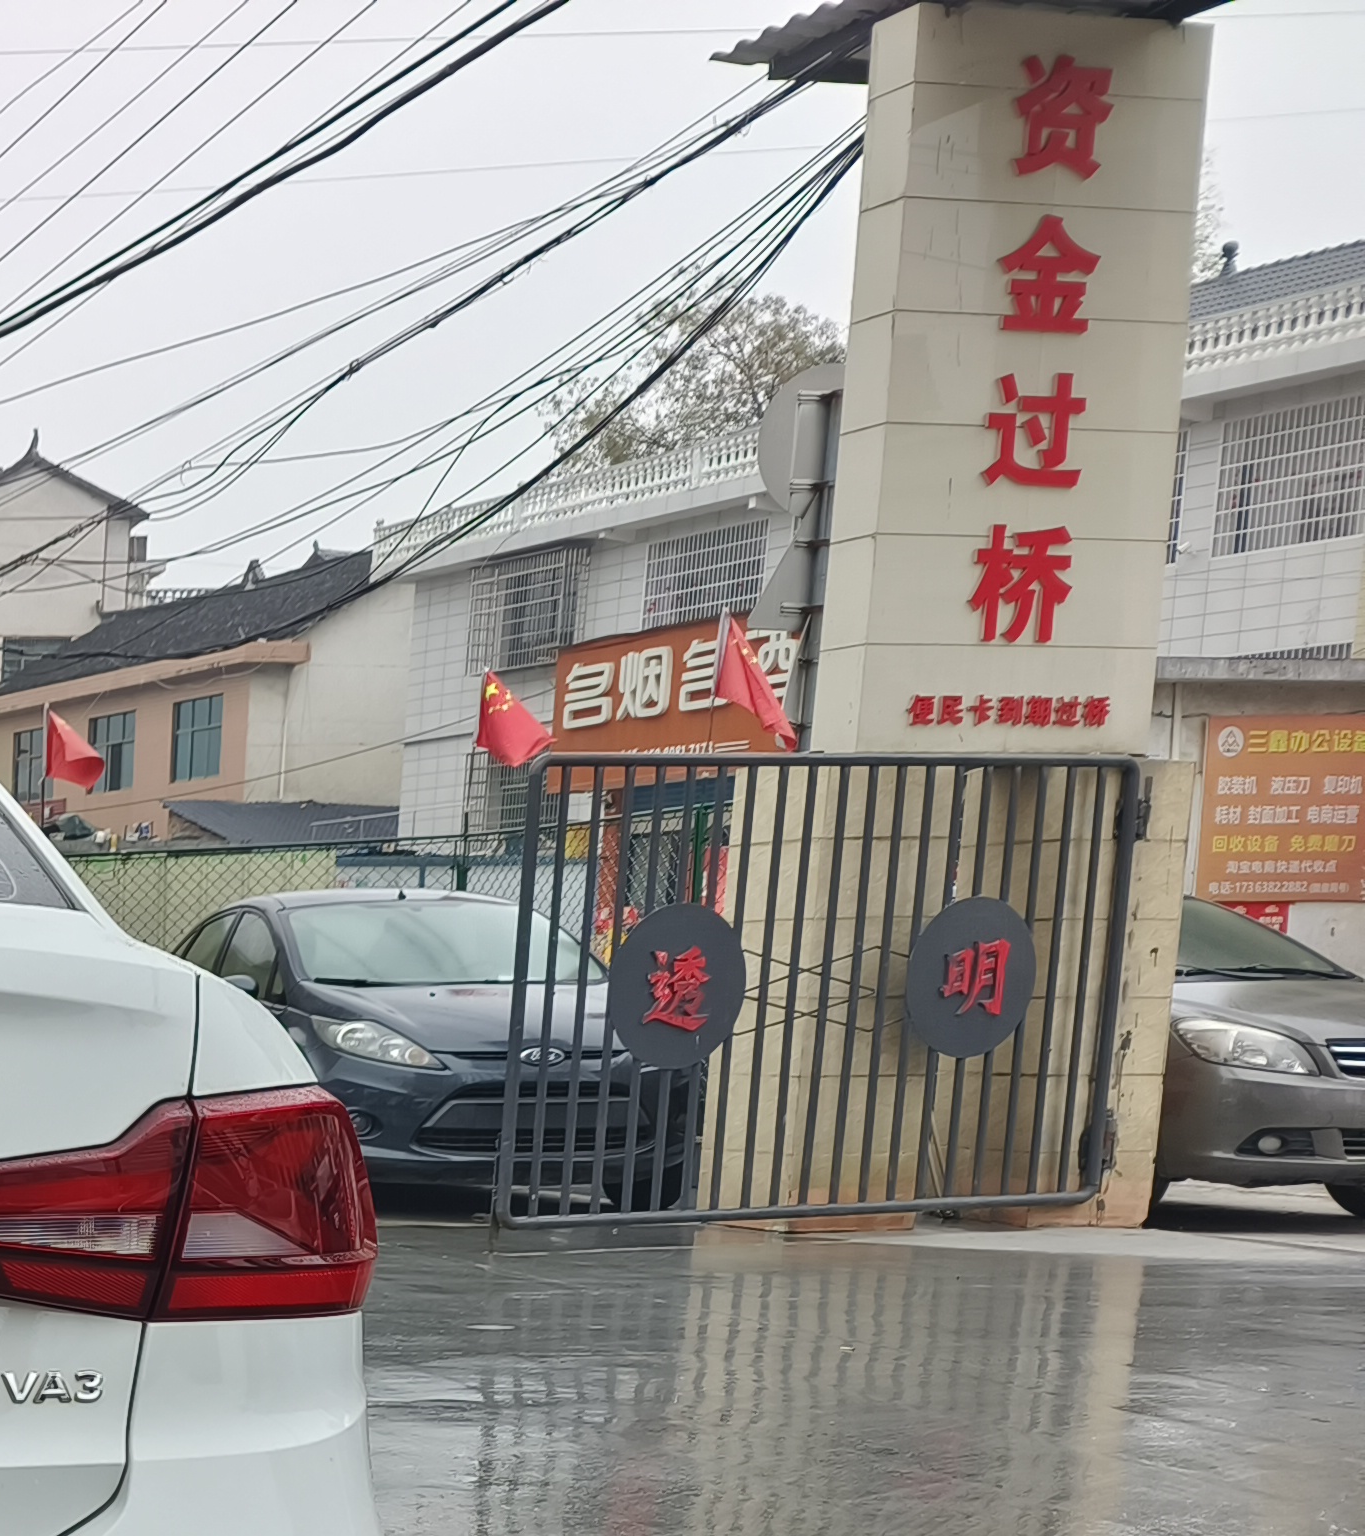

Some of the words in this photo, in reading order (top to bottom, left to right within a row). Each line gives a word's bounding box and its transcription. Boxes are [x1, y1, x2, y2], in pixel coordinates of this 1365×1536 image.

[967, 54, 1114, 644] 资金过桥
[907, 694, 1111, 727] 便民卡到期过桥
[1217, 776, 1257, 795] 胶装机
[1271, 776, 1311, 795] 液压刀
[1323, 775, 1362, 795] 复印机
[1214, 805, 1242, 824] 耗材
[1247, 805, 1301, 825] 封面加工
[1306, 804, 1360, 824] 电商运营
[1212, 835, 1279, 853] 回收设备
[1290, 834, 1357, 852] 免费磨刀
[642, 944, 711, 1032] 透
[940, 938, 1011, 1018] 明
[0, 1369, 104, 1405] VA3
